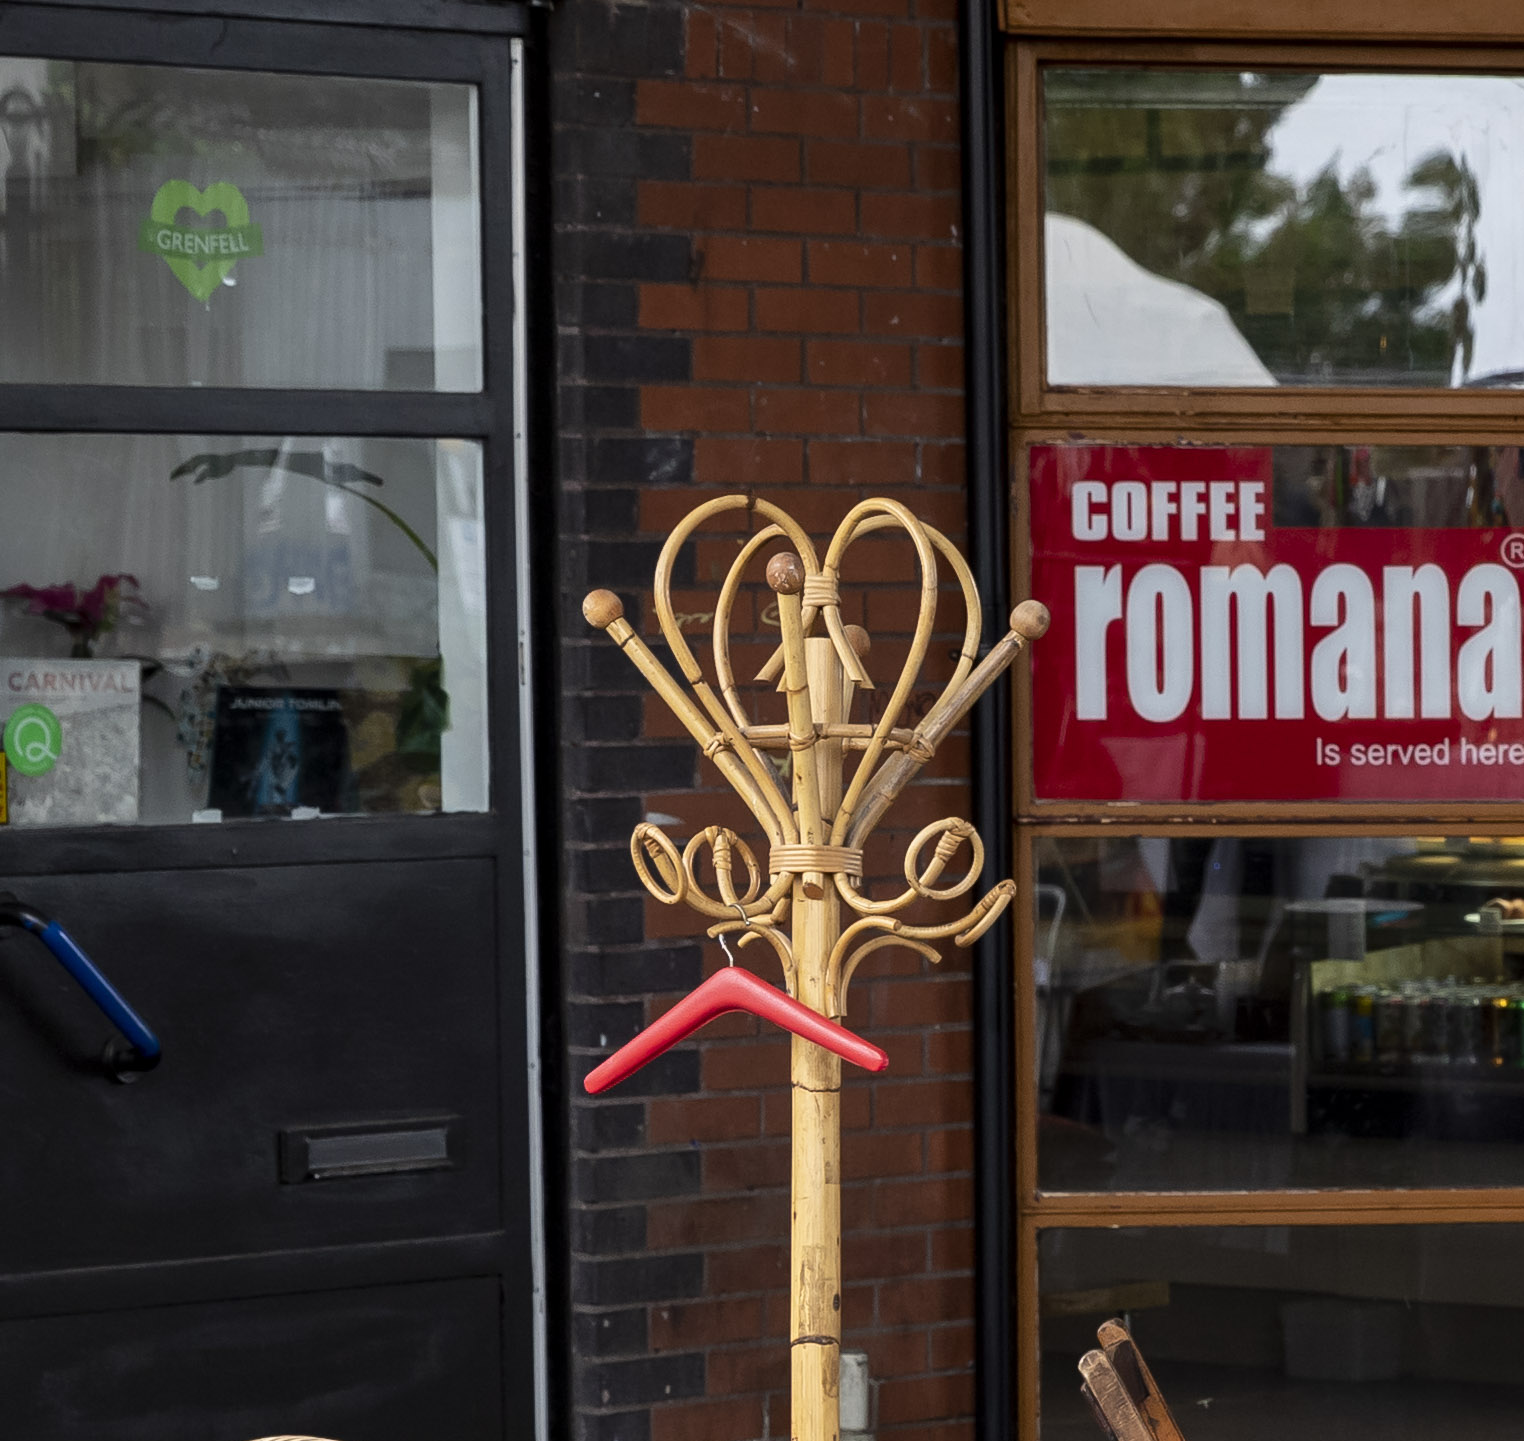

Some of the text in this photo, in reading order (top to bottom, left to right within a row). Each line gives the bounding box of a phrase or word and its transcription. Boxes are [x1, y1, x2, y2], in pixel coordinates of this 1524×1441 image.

[157, 229, 249, 254] GRENFELL
[1071, 481, 1265, 542] COFFEE
[1075, 562, 1523, 723] romana
[8, 670, 135, 692] CARNIVAL
[1316, 738, 1341, 766] Is
[1350, 738, 1450, 766] served
